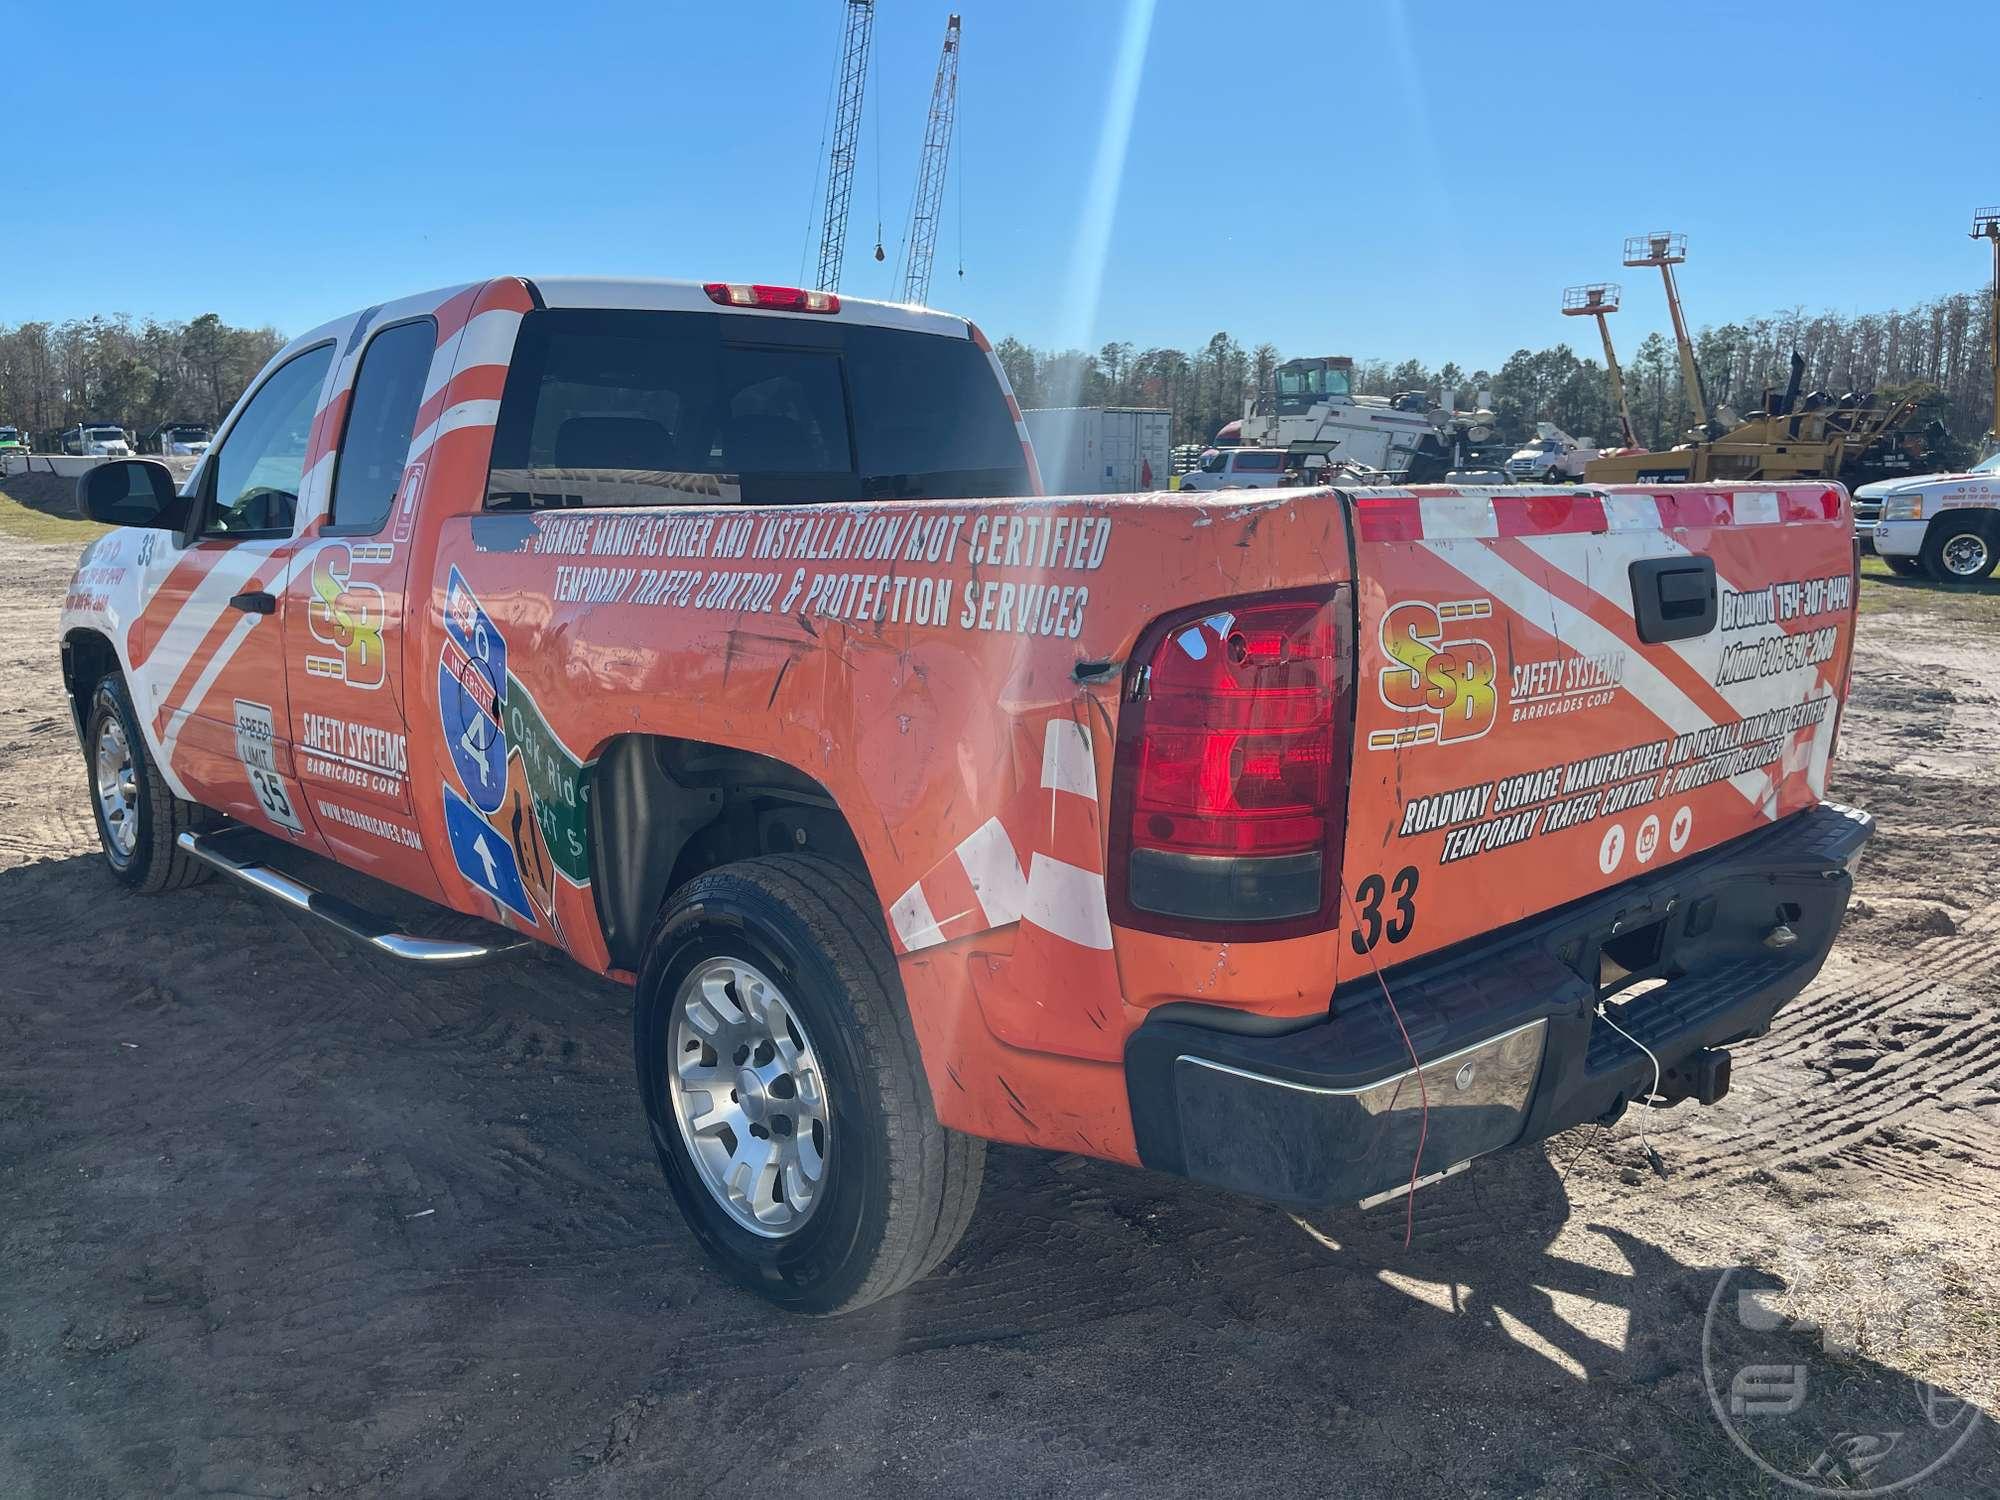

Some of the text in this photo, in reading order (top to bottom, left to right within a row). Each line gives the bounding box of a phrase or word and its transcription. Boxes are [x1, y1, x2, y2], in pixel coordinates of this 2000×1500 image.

[138, 534, 156, 567] 33
[534, 516, 593, 555] SIGNAGE
[591, 516, 715, 558] MANUFACTURER
[711, 517, 755, 559] AND
[751, 511, 967, 562] INSTALLATION/MOT
[968, 514, 1112, 569] CERTIFIED
[1875, 528, 1889, 537] 32
[553, 565, 1090, 639] TEMPORARY TRAFFIC CONTROL & PROTECTION SERVICES
[1720, 582, 1777, 632] Broward
[450, 655, 496, 713] INTERSTAT
[1511, 651, 1626, 698] SAFETY SYSTEMS
[1716, 636, 1766, 687] Miami
[238, 715, 271, 741] SPEED
[1511, 690, 1615, 722] BARRICADES CORP
[242, 743, 270, 771] LIMIT
[303, 712, 407, 773] SAFETY SYSTEMS
[461, 711, 490, 787] 4
[511, 706, 541, 771] Oak
[306, 757, 368, 788] BARRICADES
[1399, 779, 1495, 838] ROADWAY
[1493, 765, 1563, 813] SIGNAGE
[1562, 738, 1668, 796] MANUFACTURER
[1667, 731, 1696, 767] AND
[1786, 695, 1829, 733] CERTIFIE
[253, 770, 291, 817] 35
[1440, 738, 1784, 865] TEMPORARY TRAFFIC CONTROL & PROTECTION SERVICES
[567, 827, 588, 857] S
[1352, 866, 1420, 955] 33
